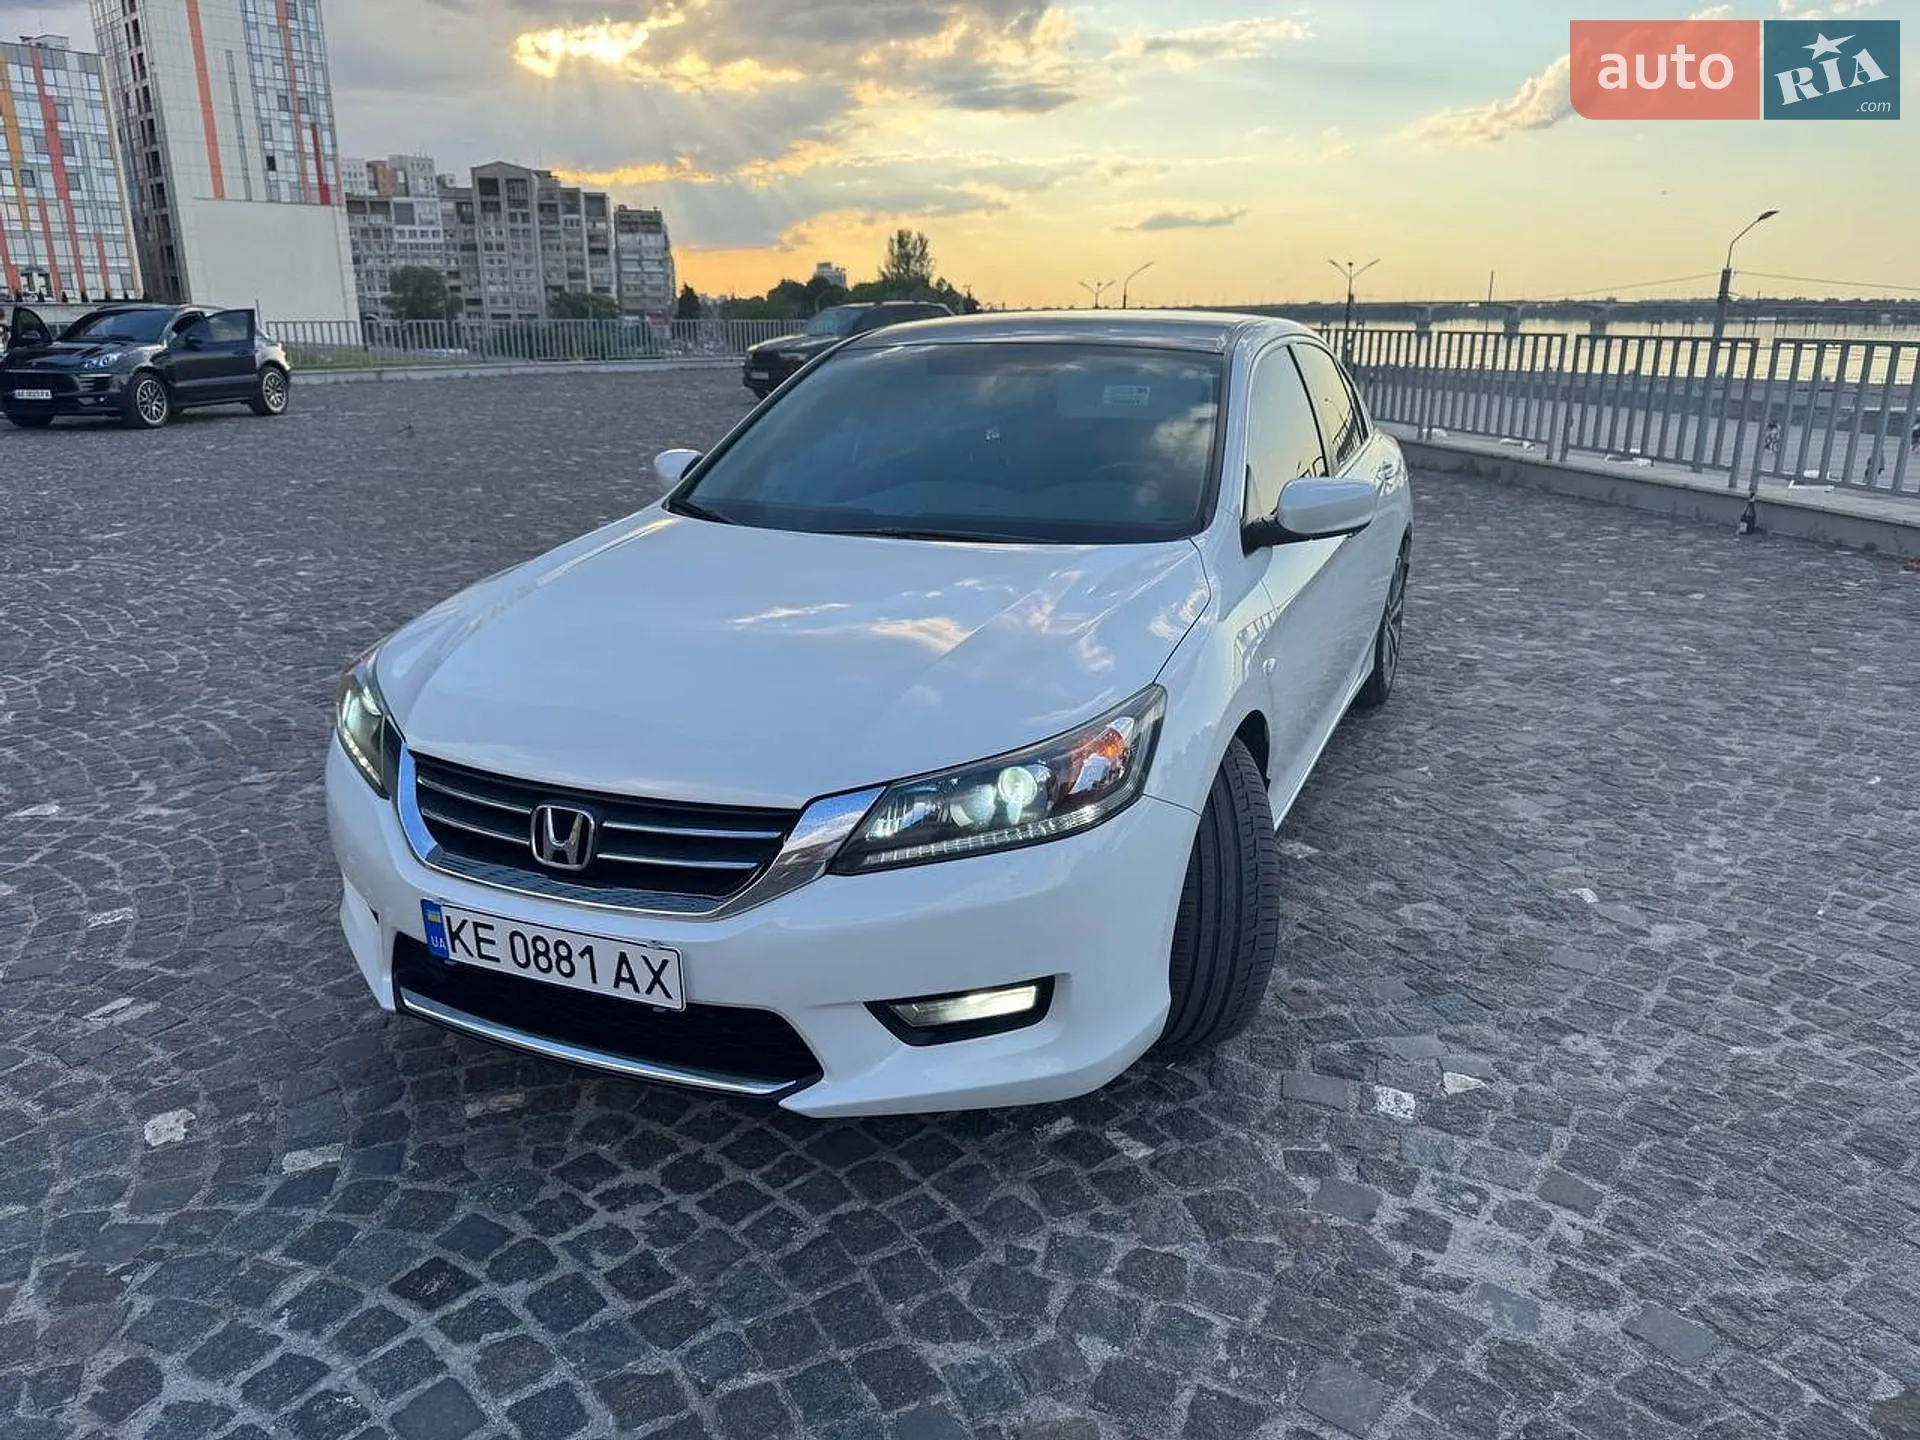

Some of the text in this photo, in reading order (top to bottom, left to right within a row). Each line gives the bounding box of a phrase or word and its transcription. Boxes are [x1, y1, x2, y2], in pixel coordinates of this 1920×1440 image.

[430, 935, 447, 951] UA
[445, 914, 674, 1000] KE 0881 AX
